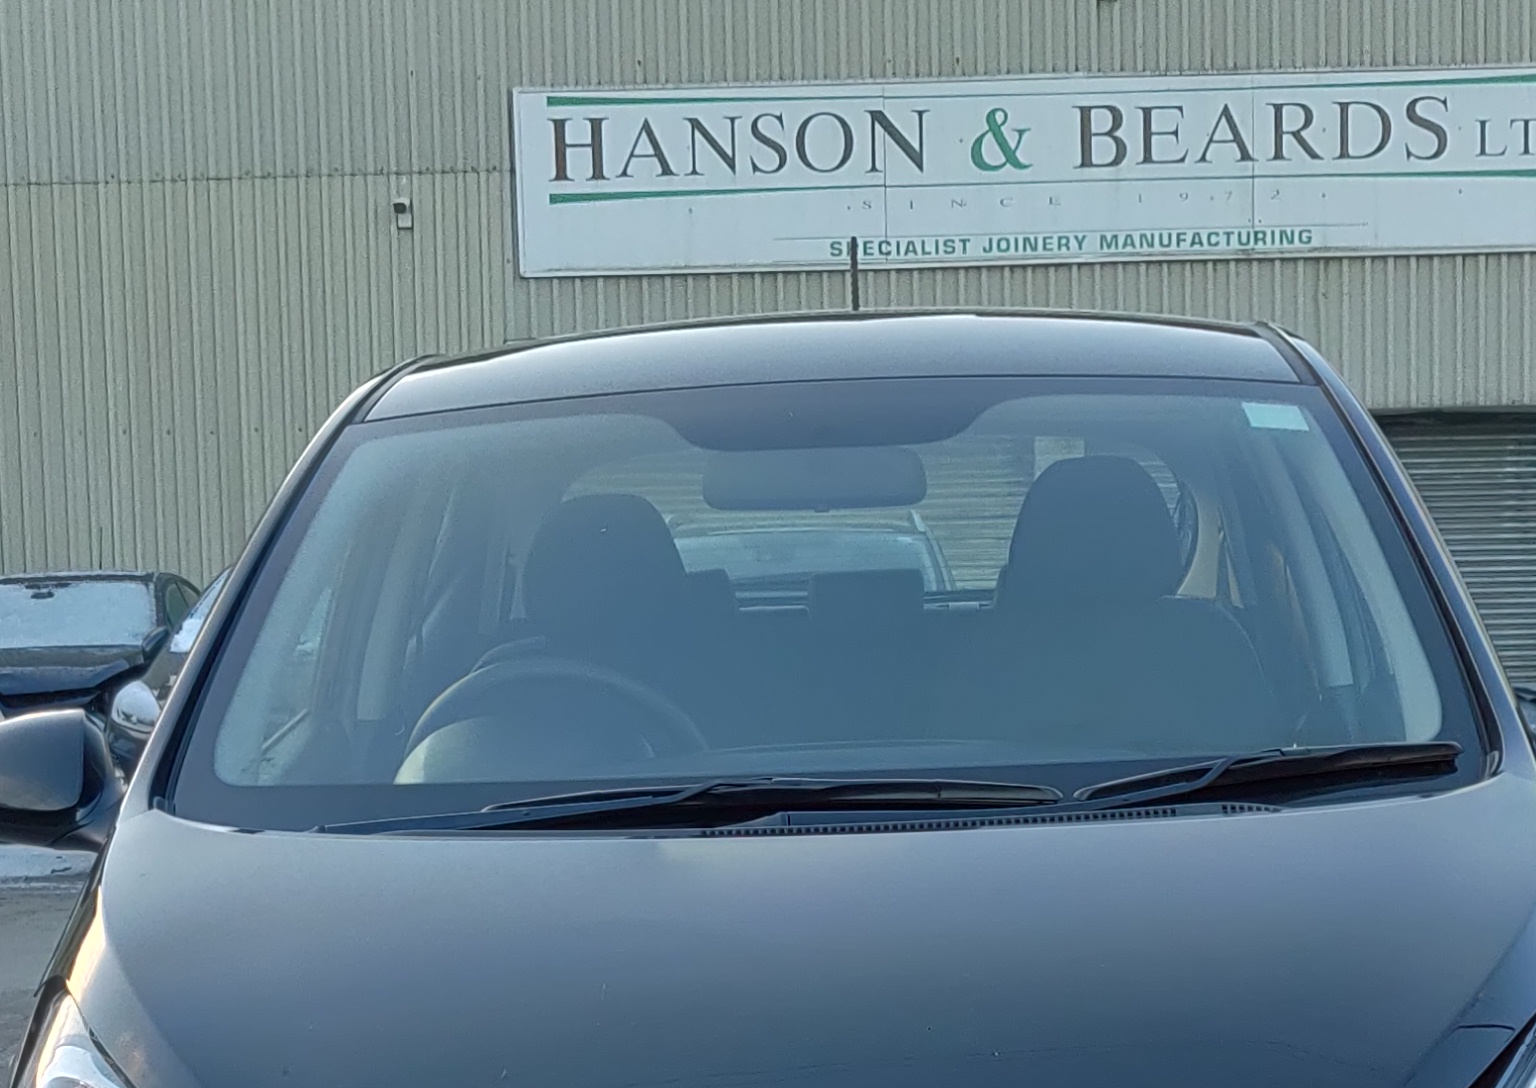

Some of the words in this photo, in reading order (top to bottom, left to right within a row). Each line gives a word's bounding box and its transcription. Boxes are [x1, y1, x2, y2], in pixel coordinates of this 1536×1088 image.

[547, 109, 931, 182] HANSON
[970, 107, 1034, 173] &
[1071, 96, 1450, 170] BEARDS
[982, 234, 1087, 254] JOINERY
[1099, 228, 1314, 252] MANUFACTURING
